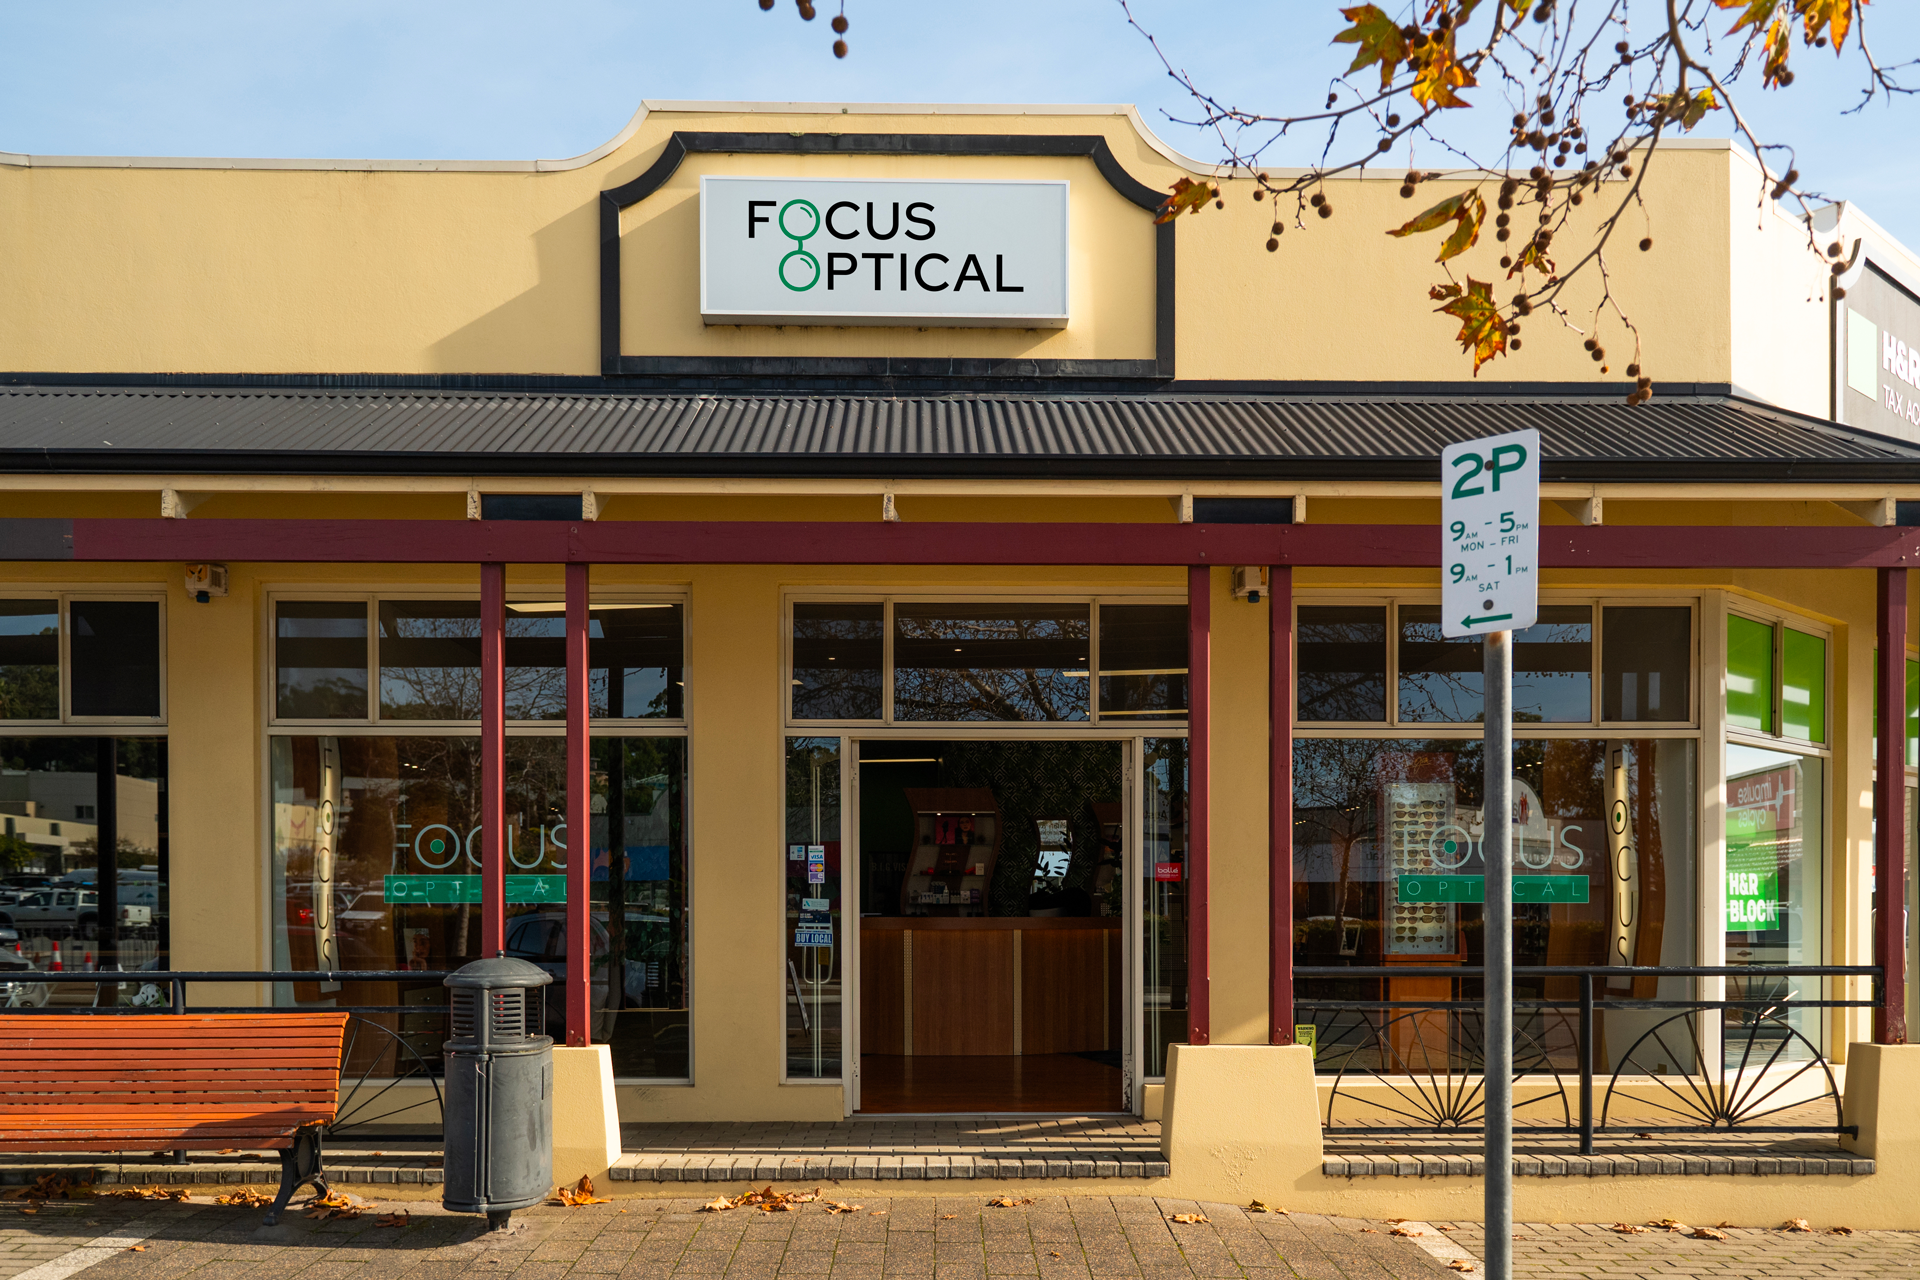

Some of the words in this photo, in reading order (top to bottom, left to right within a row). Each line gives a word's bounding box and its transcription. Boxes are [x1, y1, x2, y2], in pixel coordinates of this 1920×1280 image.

[748, 199, 936, 241] FOCUS
[778, 249, 1024, 292] OPTICAL
[1882, 330, 1920, 391] H&R
[1882, 384, 1903, 417] TAX
[1451, 444, 1527, 500] 2P
[1461, 541, 1484, 553] MON
[1501, 535, 1519, 546] FRI
[1478, 581, 1500, 593] SAT
[1404, 825, 1584, 869] FOUS
[393, 881, 567, 896] OPTCAL
[1406, 881, 1581, 896] OPTCAL
[1729, 872, 1759, 896] H&R
[1730, 898, 1776, 923] BLOCK
[796, 933, 810, 943] BUY
[811, 934, 832, 944] LOCAL
